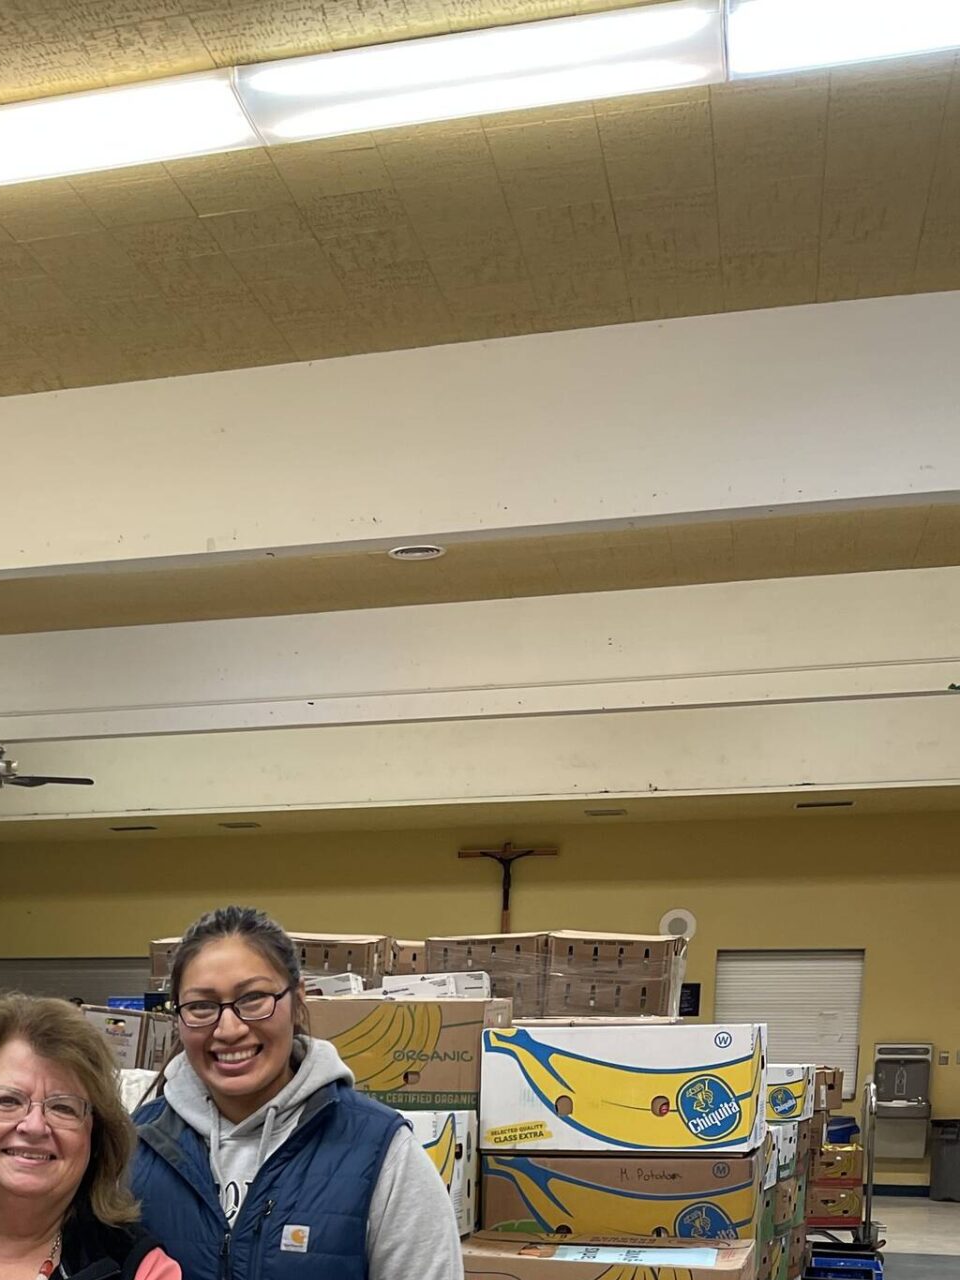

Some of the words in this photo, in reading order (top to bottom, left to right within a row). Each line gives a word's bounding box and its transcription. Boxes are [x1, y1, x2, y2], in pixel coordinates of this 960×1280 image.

[392, 1050, 473, 1062] ORGANIC
[386, 1094, 431, 1105] CERTIFIED
[434, 1095, 477, 1105] ORGANIC
[688, 1100, 740, 1135] Chiquita
[517, 1124, 544, 1133] QUALITY
[494, 1134, 517, 1144] CLASS
[518, 1131, 545, 1141] EXTRA
